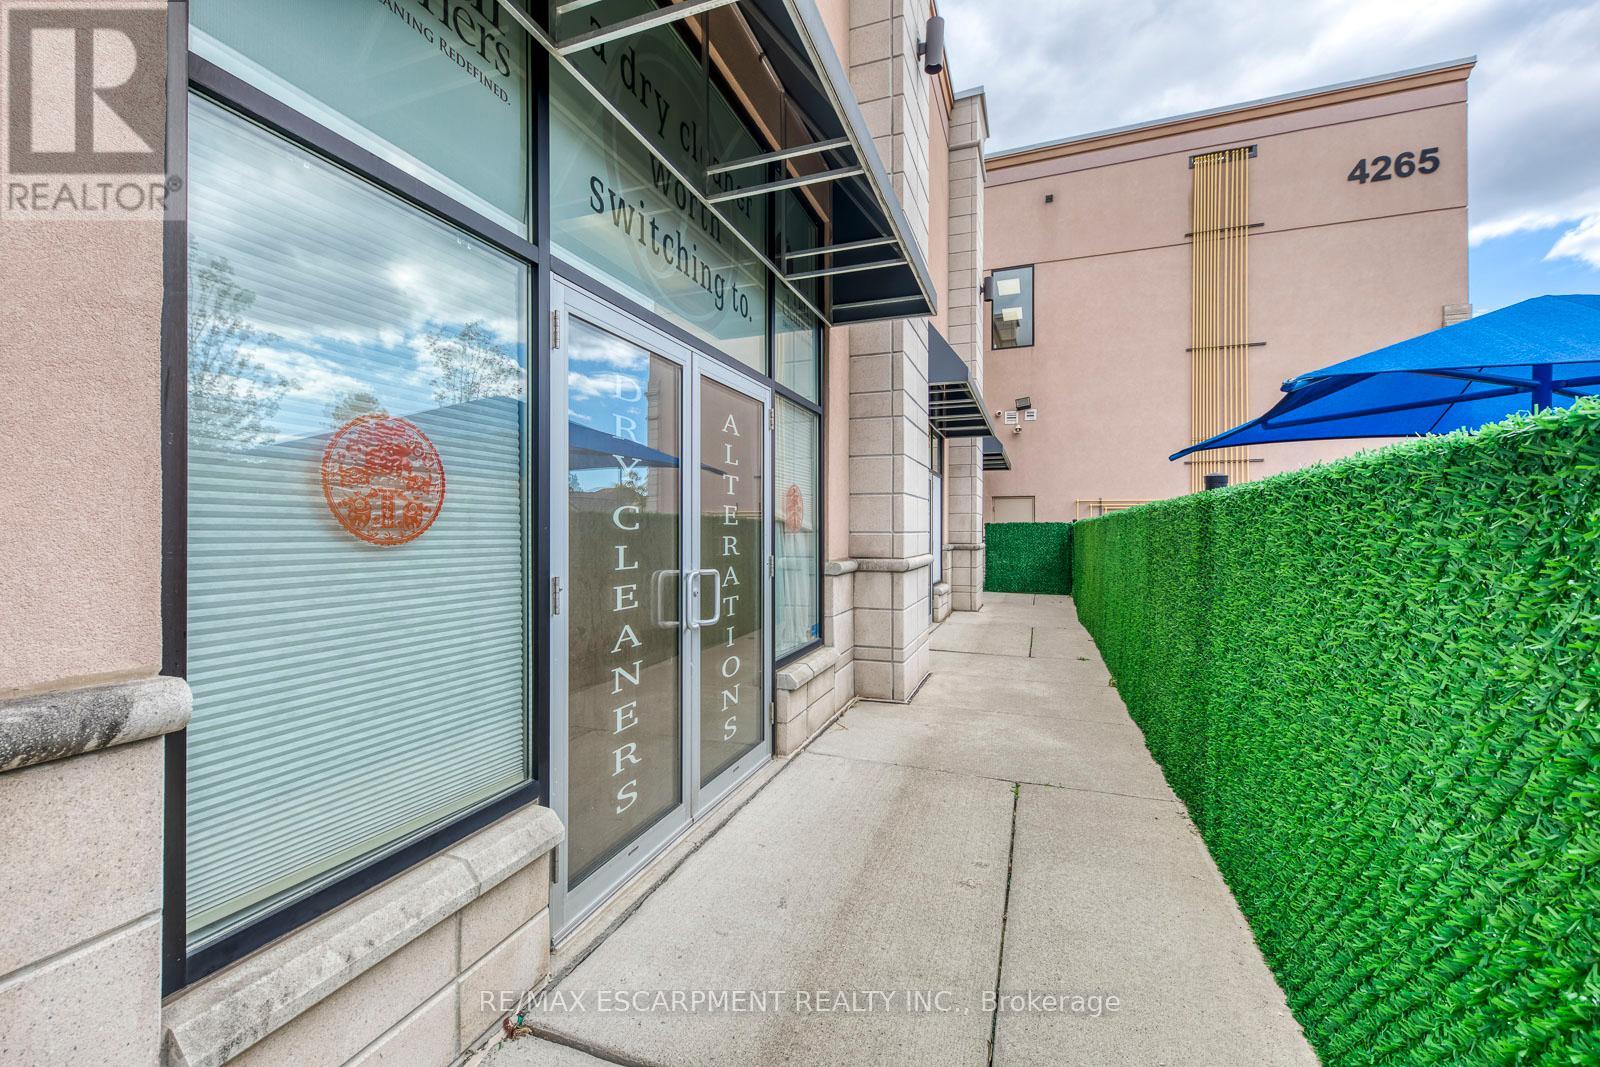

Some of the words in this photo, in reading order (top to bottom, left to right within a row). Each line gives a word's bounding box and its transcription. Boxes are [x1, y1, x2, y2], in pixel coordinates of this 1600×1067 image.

[439, 36, 511, 106] REDEFINED.
[620, 45, 670, 140] dry
[1347, 147, 1440, 184] 4265
[590, 176, 726, 311] switching
[732, 283, 752, 322] to.
[721, 413, 741, 742] ALTERATIONS
